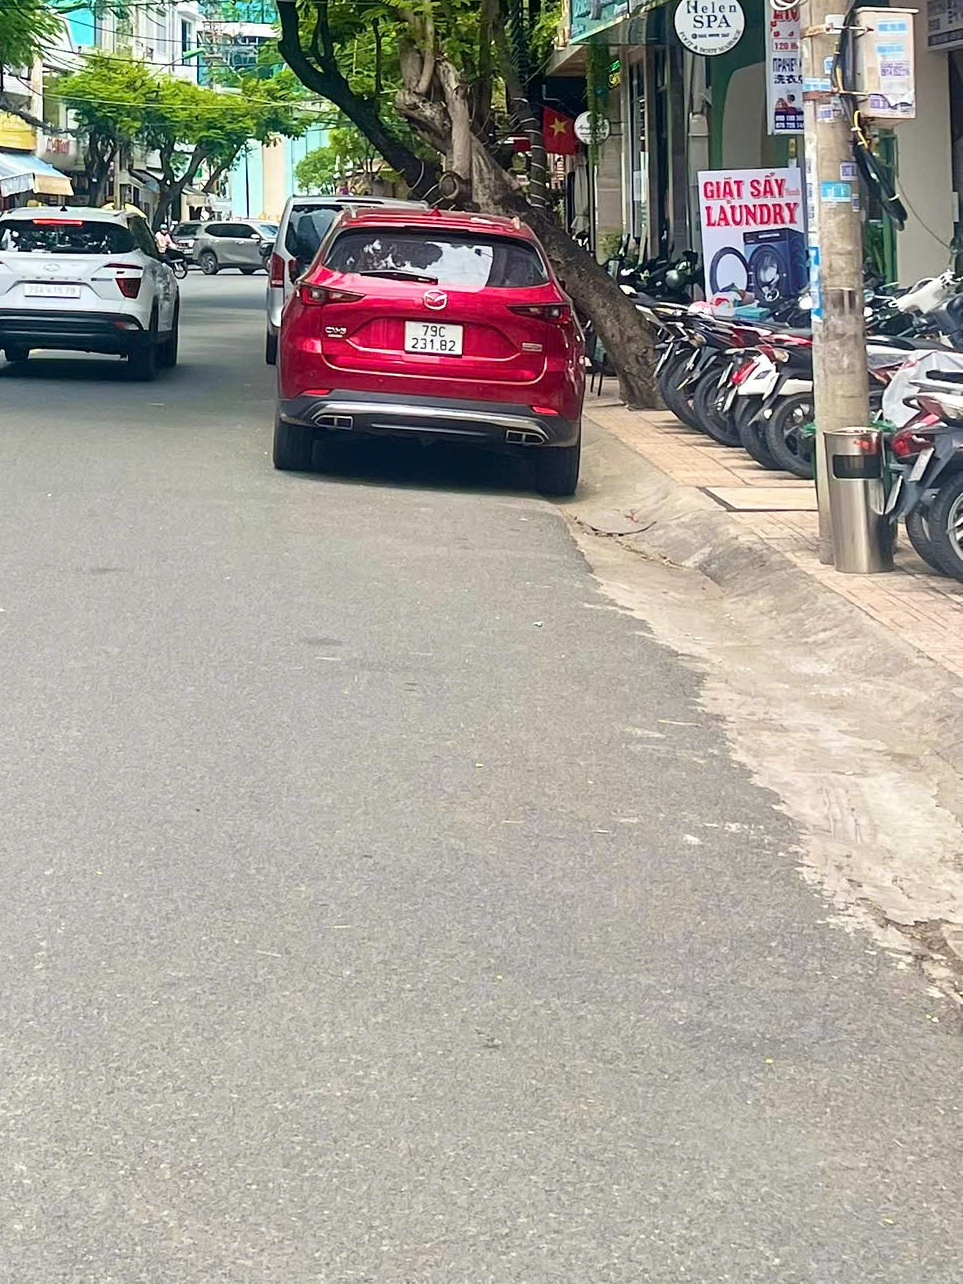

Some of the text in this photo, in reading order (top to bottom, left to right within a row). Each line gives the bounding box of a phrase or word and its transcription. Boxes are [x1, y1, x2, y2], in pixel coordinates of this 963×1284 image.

[687, 0, 737, 14] Helen
[693, 14, 731, 29] SPA
[705, 202, 799, 227] LAUNDRY
[422, 324, 446, 338] 79C
[411, 337, 456, 352] 231.82
